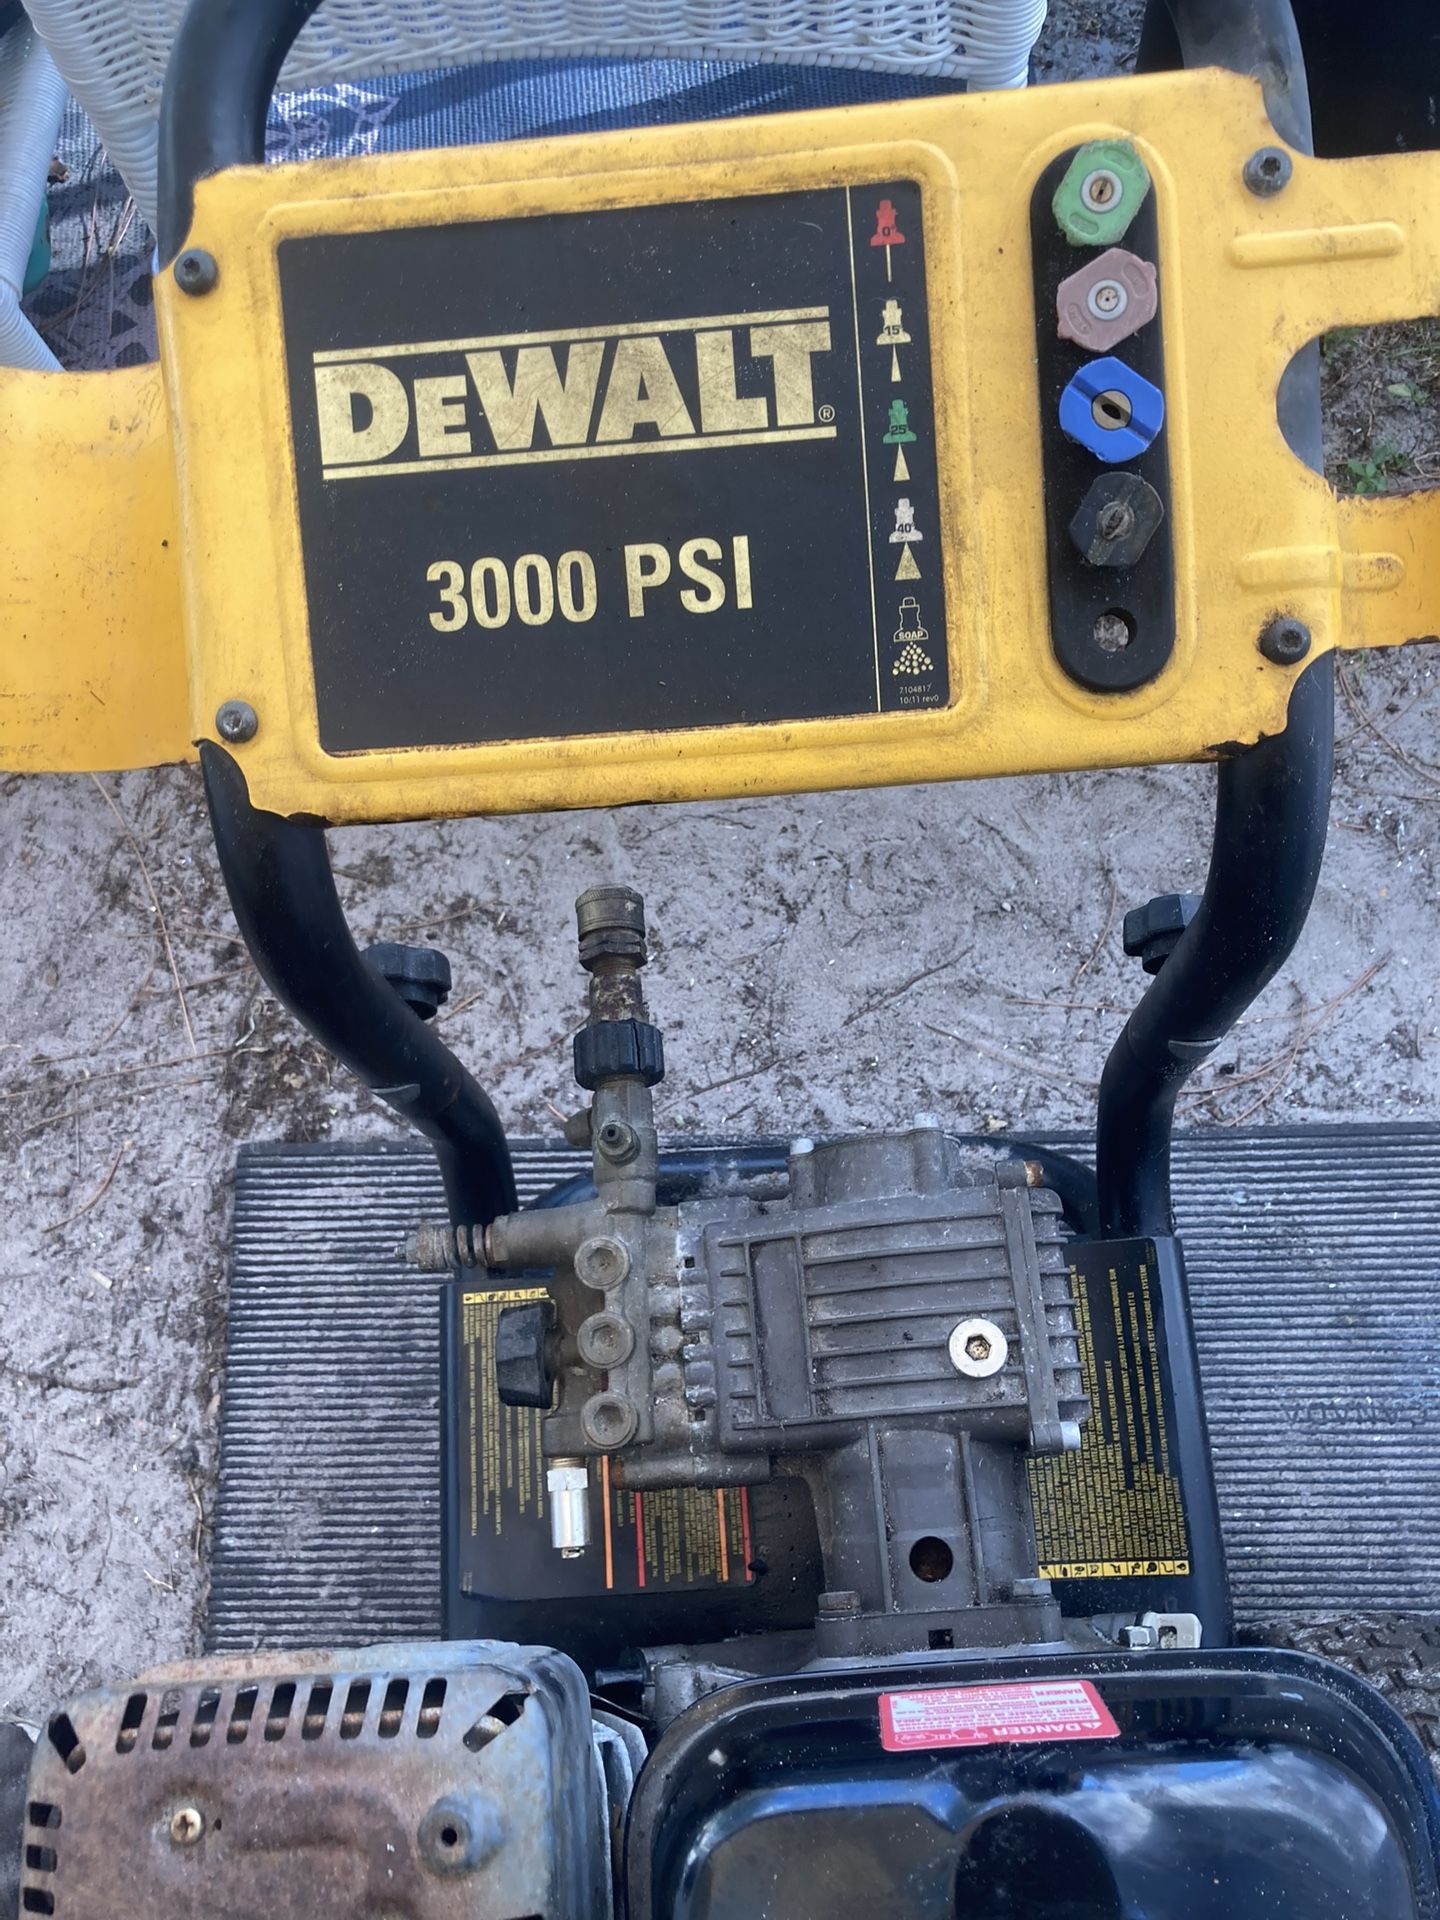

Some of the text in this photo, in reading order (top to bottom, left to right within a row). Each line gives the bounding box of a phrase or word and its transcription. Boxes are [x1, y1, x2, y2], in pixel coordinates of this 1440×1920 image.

[427, 535, 753, 633] 3000 PSI
[898, 631, 924, 640] SOAP
[992, 1722, 1081, 1736] DANGER
